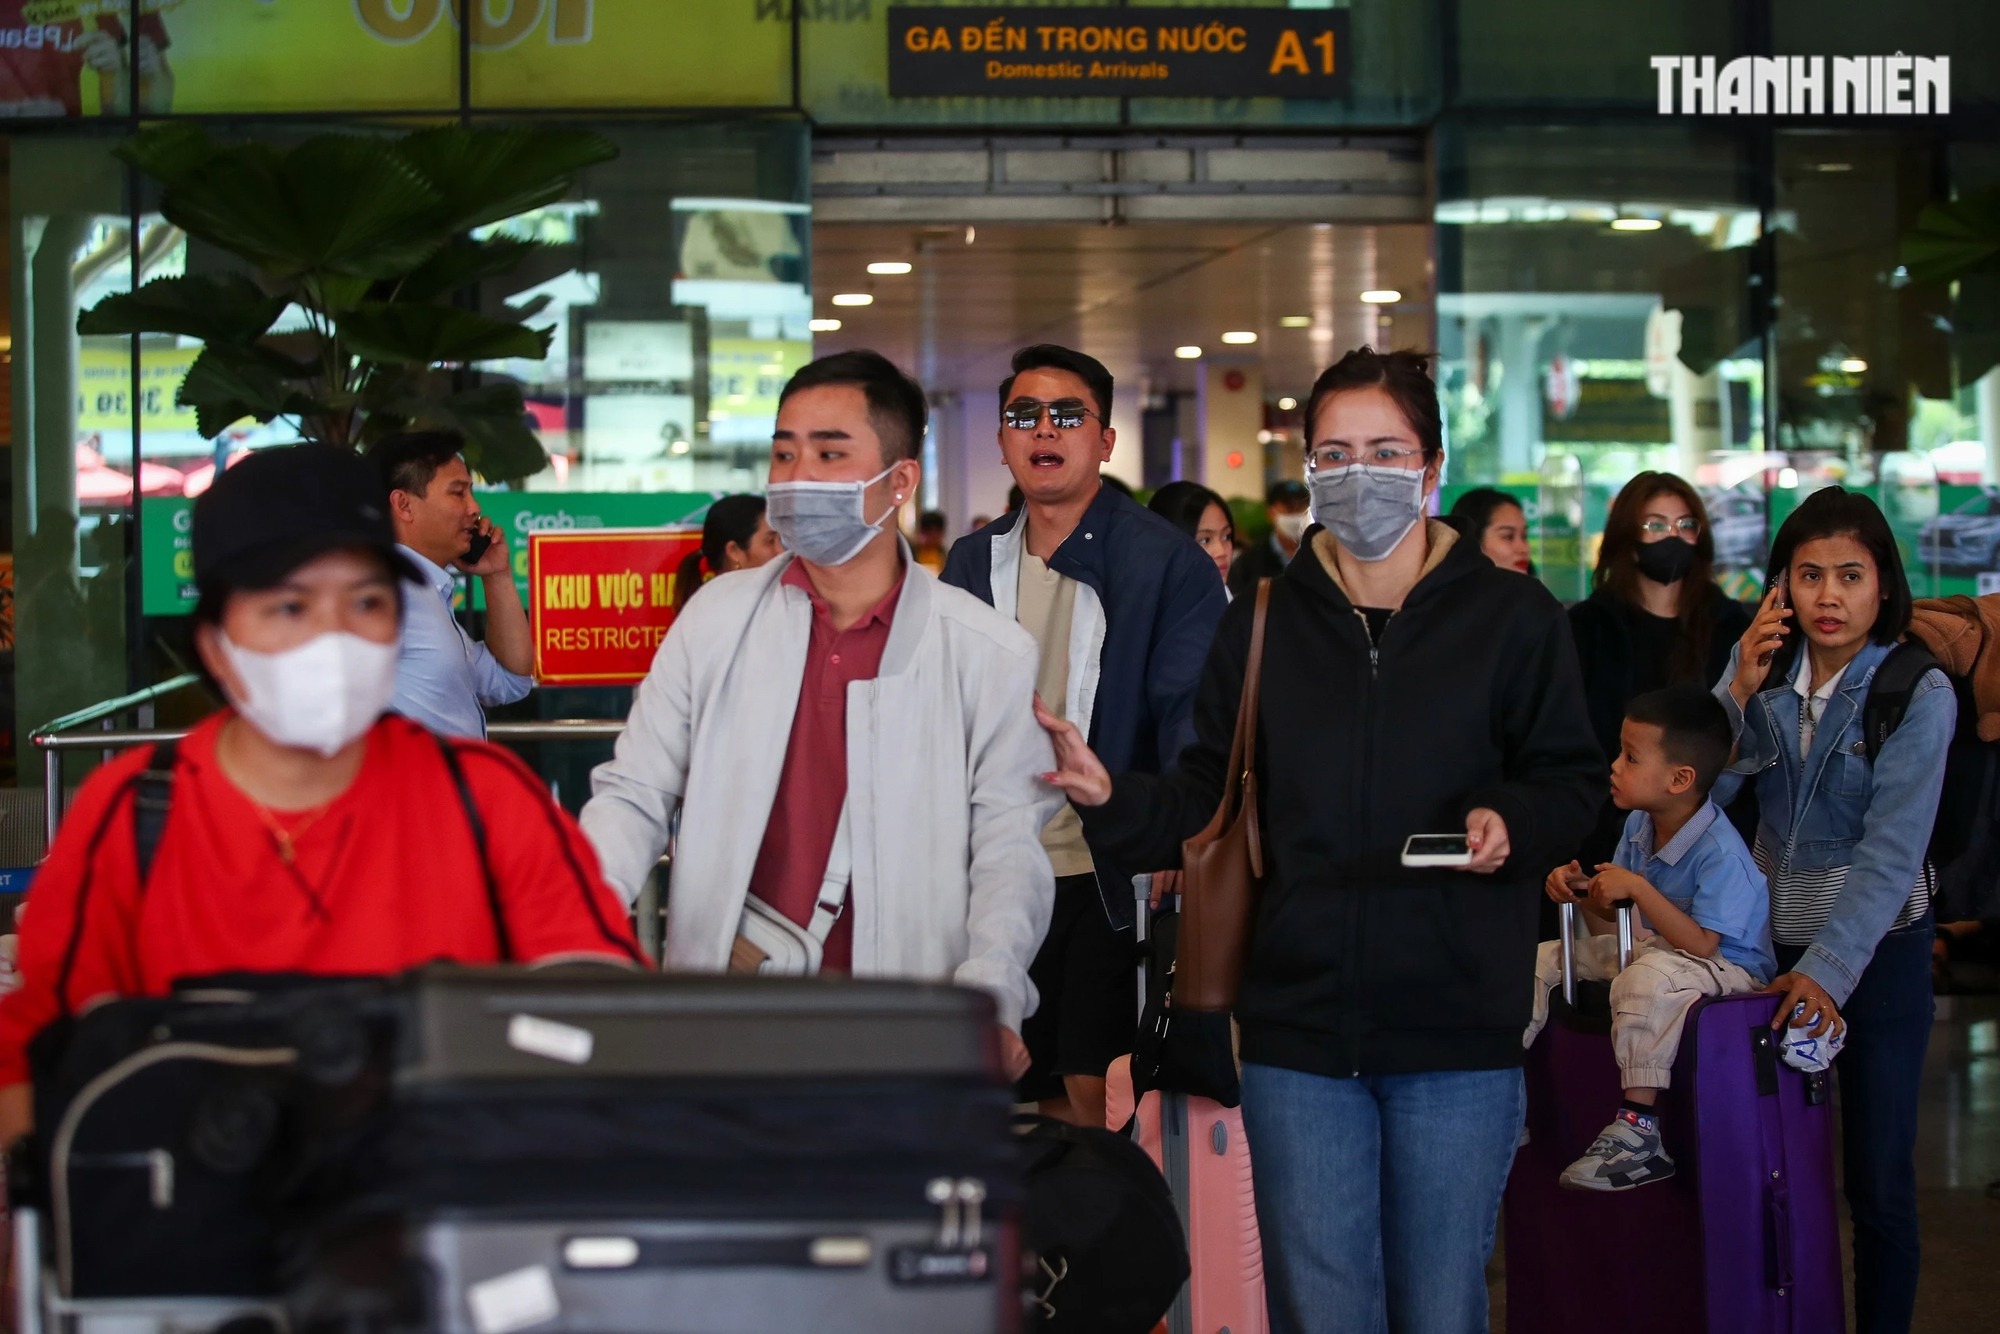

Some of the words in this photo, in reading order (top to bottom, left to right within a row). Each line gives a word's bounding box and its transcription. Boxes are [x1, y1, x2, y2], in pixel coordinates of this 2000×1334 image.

[905, 26, 951, 51] GA
[960, 16, 1027, 51] ĐẾN
[1037, 26, 1147, 52] TRONG
[1158, 20, 1246, 52] NƯỚC
[1268, 29, 1334, 75] A1
[986, 60, 1082, 78] Domestic
[1089, 60, 1168, 78] Arrivals
[514, 510, 575, 532] Grab
[545, 574, 591, 609] KHU
[597, 568, 643, 615] VỰC
[546, 627, 666, 650] RESTRICTE
